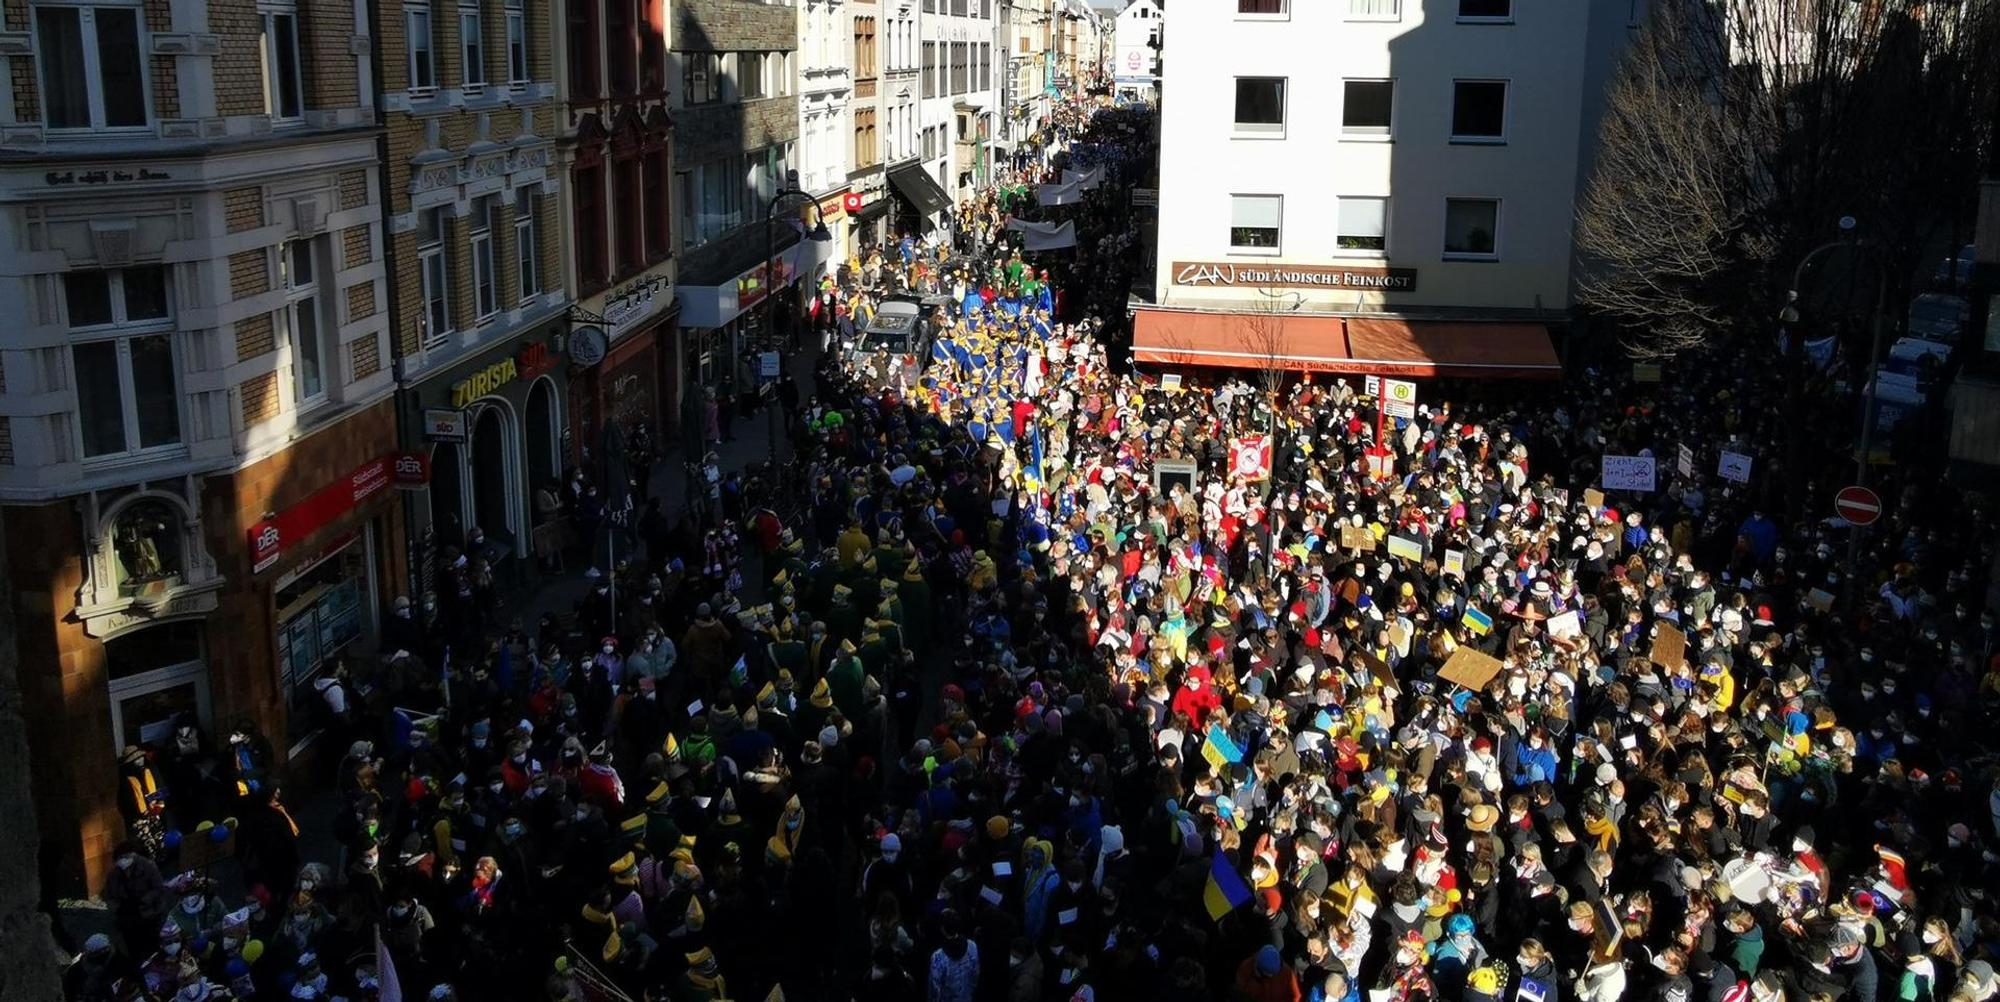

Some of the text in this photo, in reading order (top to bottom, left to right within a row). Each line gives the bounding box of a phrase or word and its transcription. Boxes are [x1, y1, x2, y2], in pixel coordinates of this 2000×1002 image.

[1177, 264, 1410, 288] CAN SÜDLÄNDISCHE FEINKOST
[1283, 360, 1304, 369] CAN
[453, 356, 518, 407] TURISTA
[395, 457, 422, 474] DER
[257, 527, 280, 551] DER
